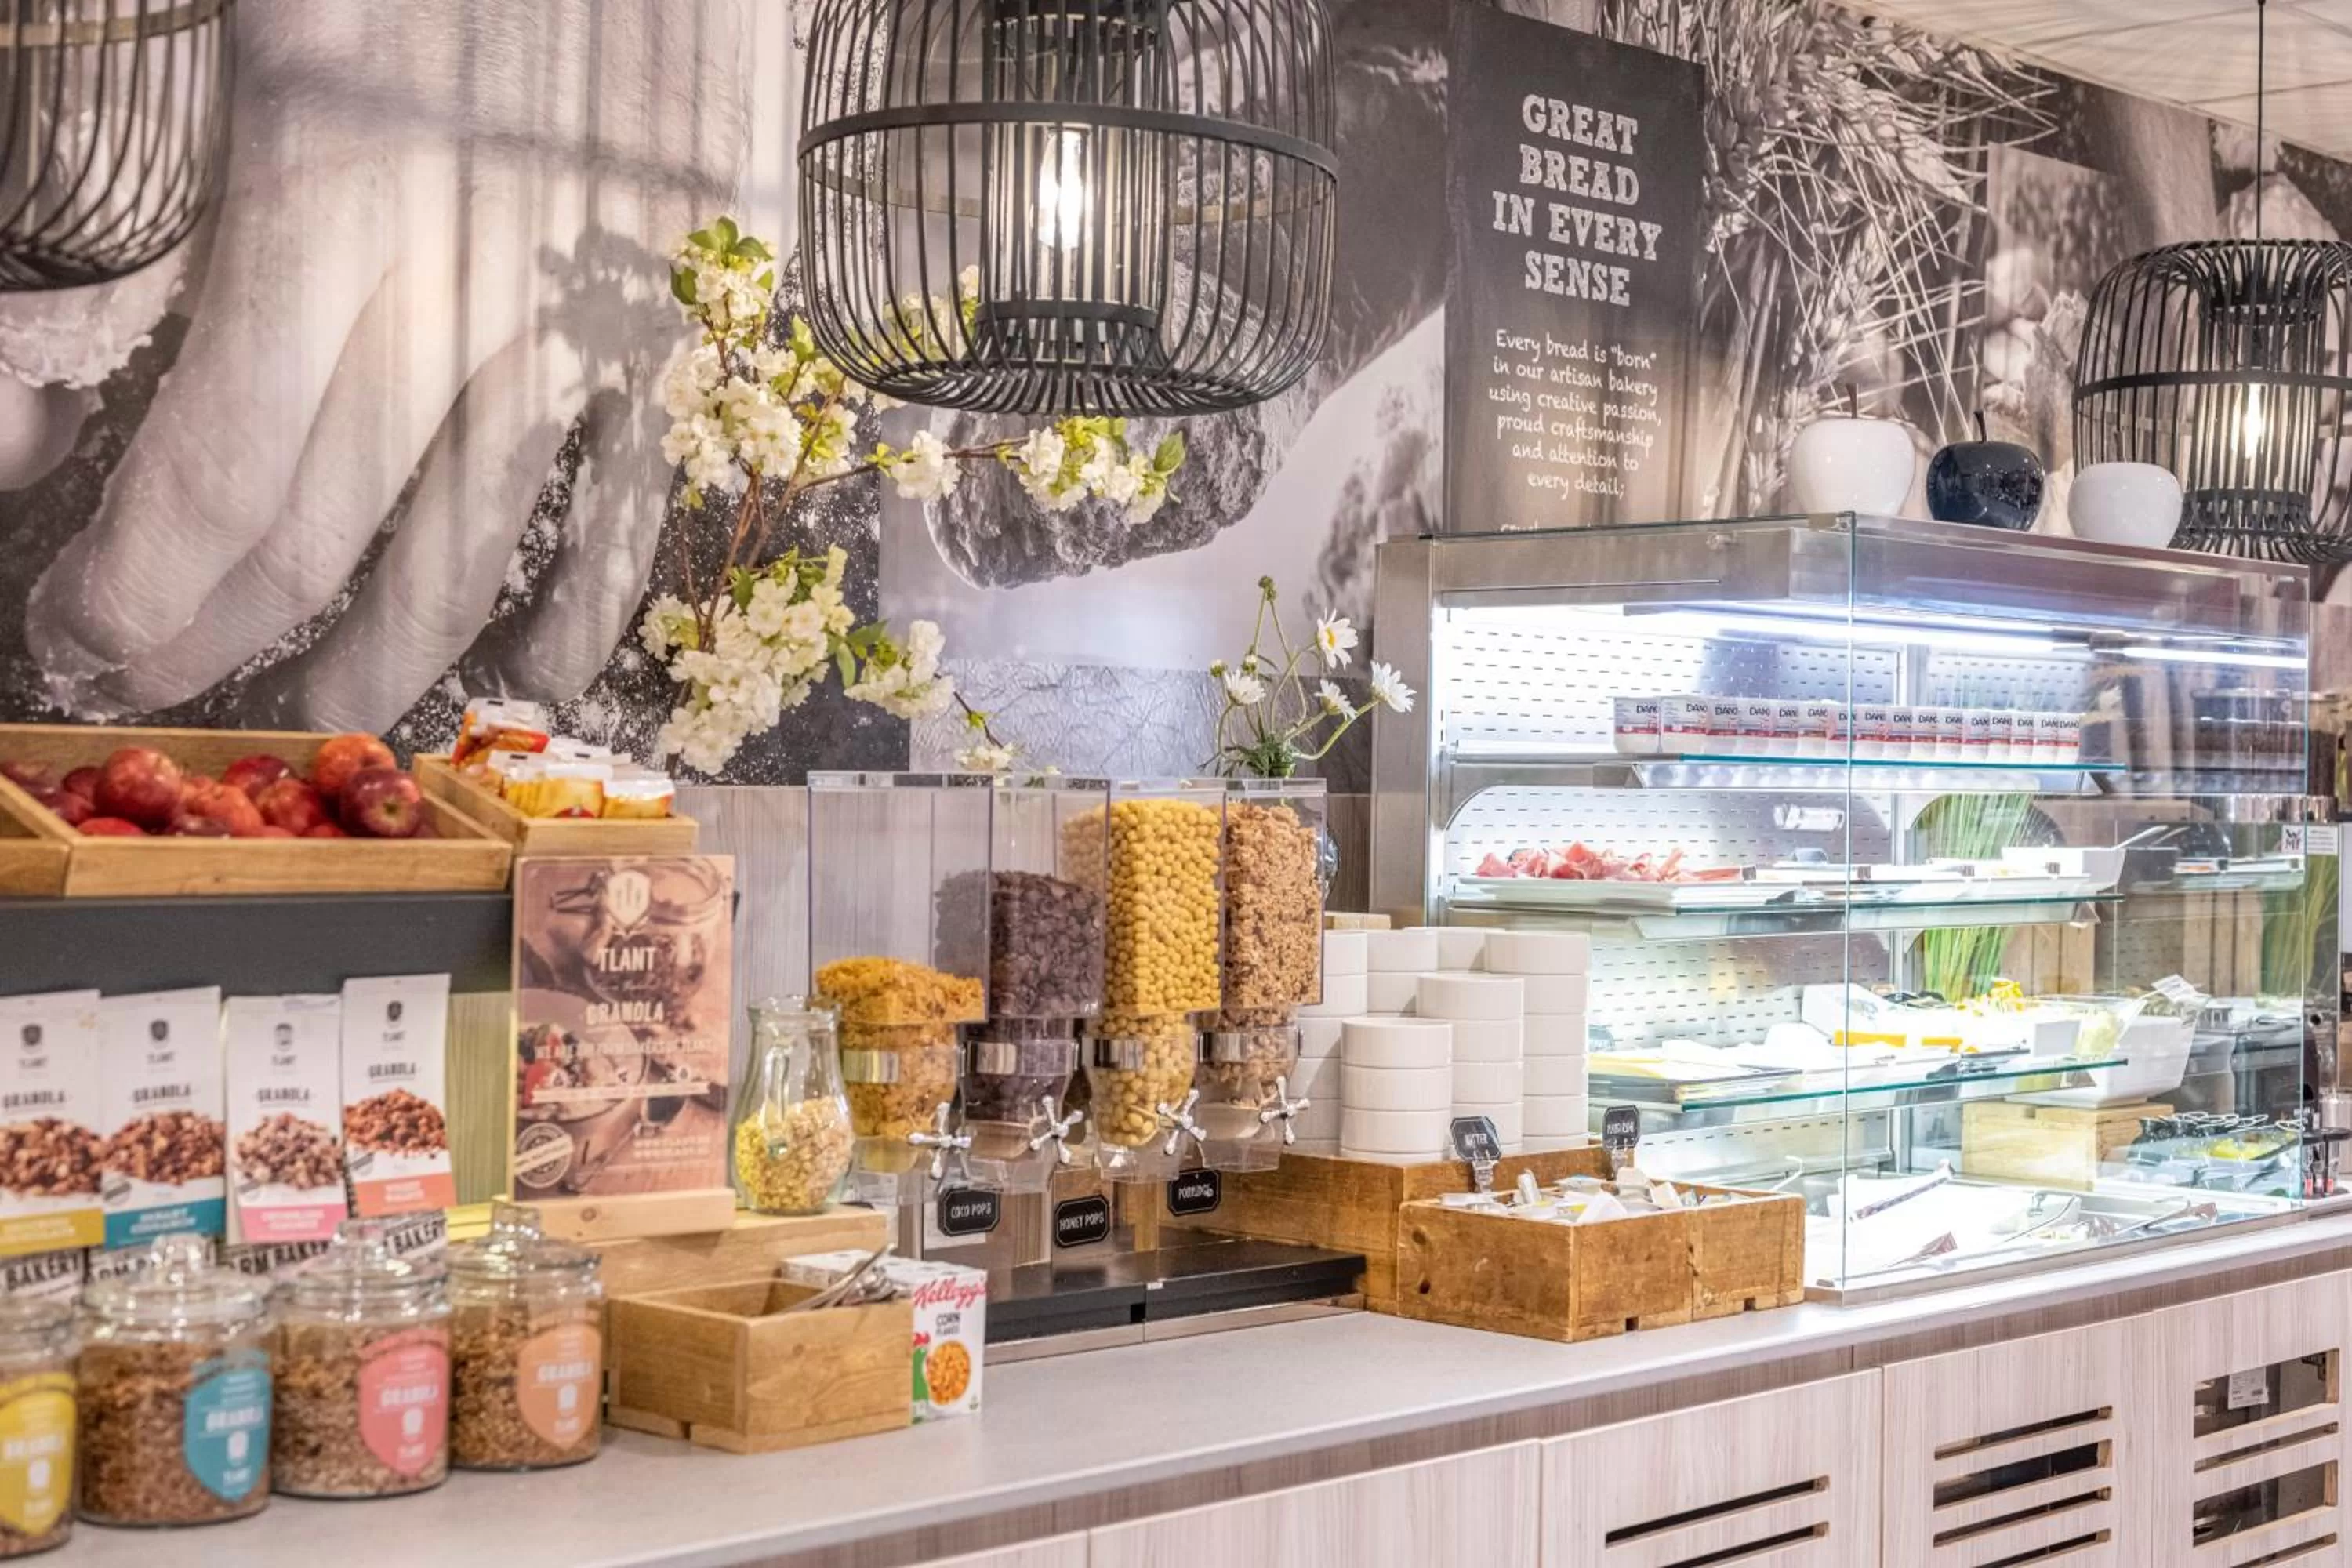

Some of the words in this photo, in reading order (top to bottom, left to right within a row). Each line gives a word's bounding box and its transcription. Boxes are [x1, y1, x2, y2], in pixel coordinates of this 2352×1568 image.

[1522, 93, 1638, 155] GREAT
[1519, 143, 1639, 205] BREAD
[1492, 191, 1535, 236] IN
[1548, 202, 1663, 261] EVERY
[1525, 250, 1631, 307] SENSE
[1497, 329, 1540, 362] Every
[1546, 332, 1588, 360] bread
[1595, 345, 1606, 363] is
[1494, 356, 1509, 375] in
[1515, 365, 1544, 379] our
[1550, 365, 1603, 389] artisan
[1609, 369, 1658, 406] bakery
[1490, 385, 1531, 412] using
[1537, 392, 1597, 414] creative
[1603, 402, 1661, 426] passion,
[1497, 414, 1544, 439] proud
[1550, 417, 1653, 458] craftsmanship
[1512, 441, 1544, 461] and
[1549, 445, 1617, 468] attention
[1624, 452, 1639, 471] to
[1527, 473, 1569, 500] every
[950, 1205, 970, 1219] COCO
[971, 1202, 992, 1217] POPS
[1084, 1211, 1105, 1227] POPS
[914, 1276, 986, 1310] Kellogg's
